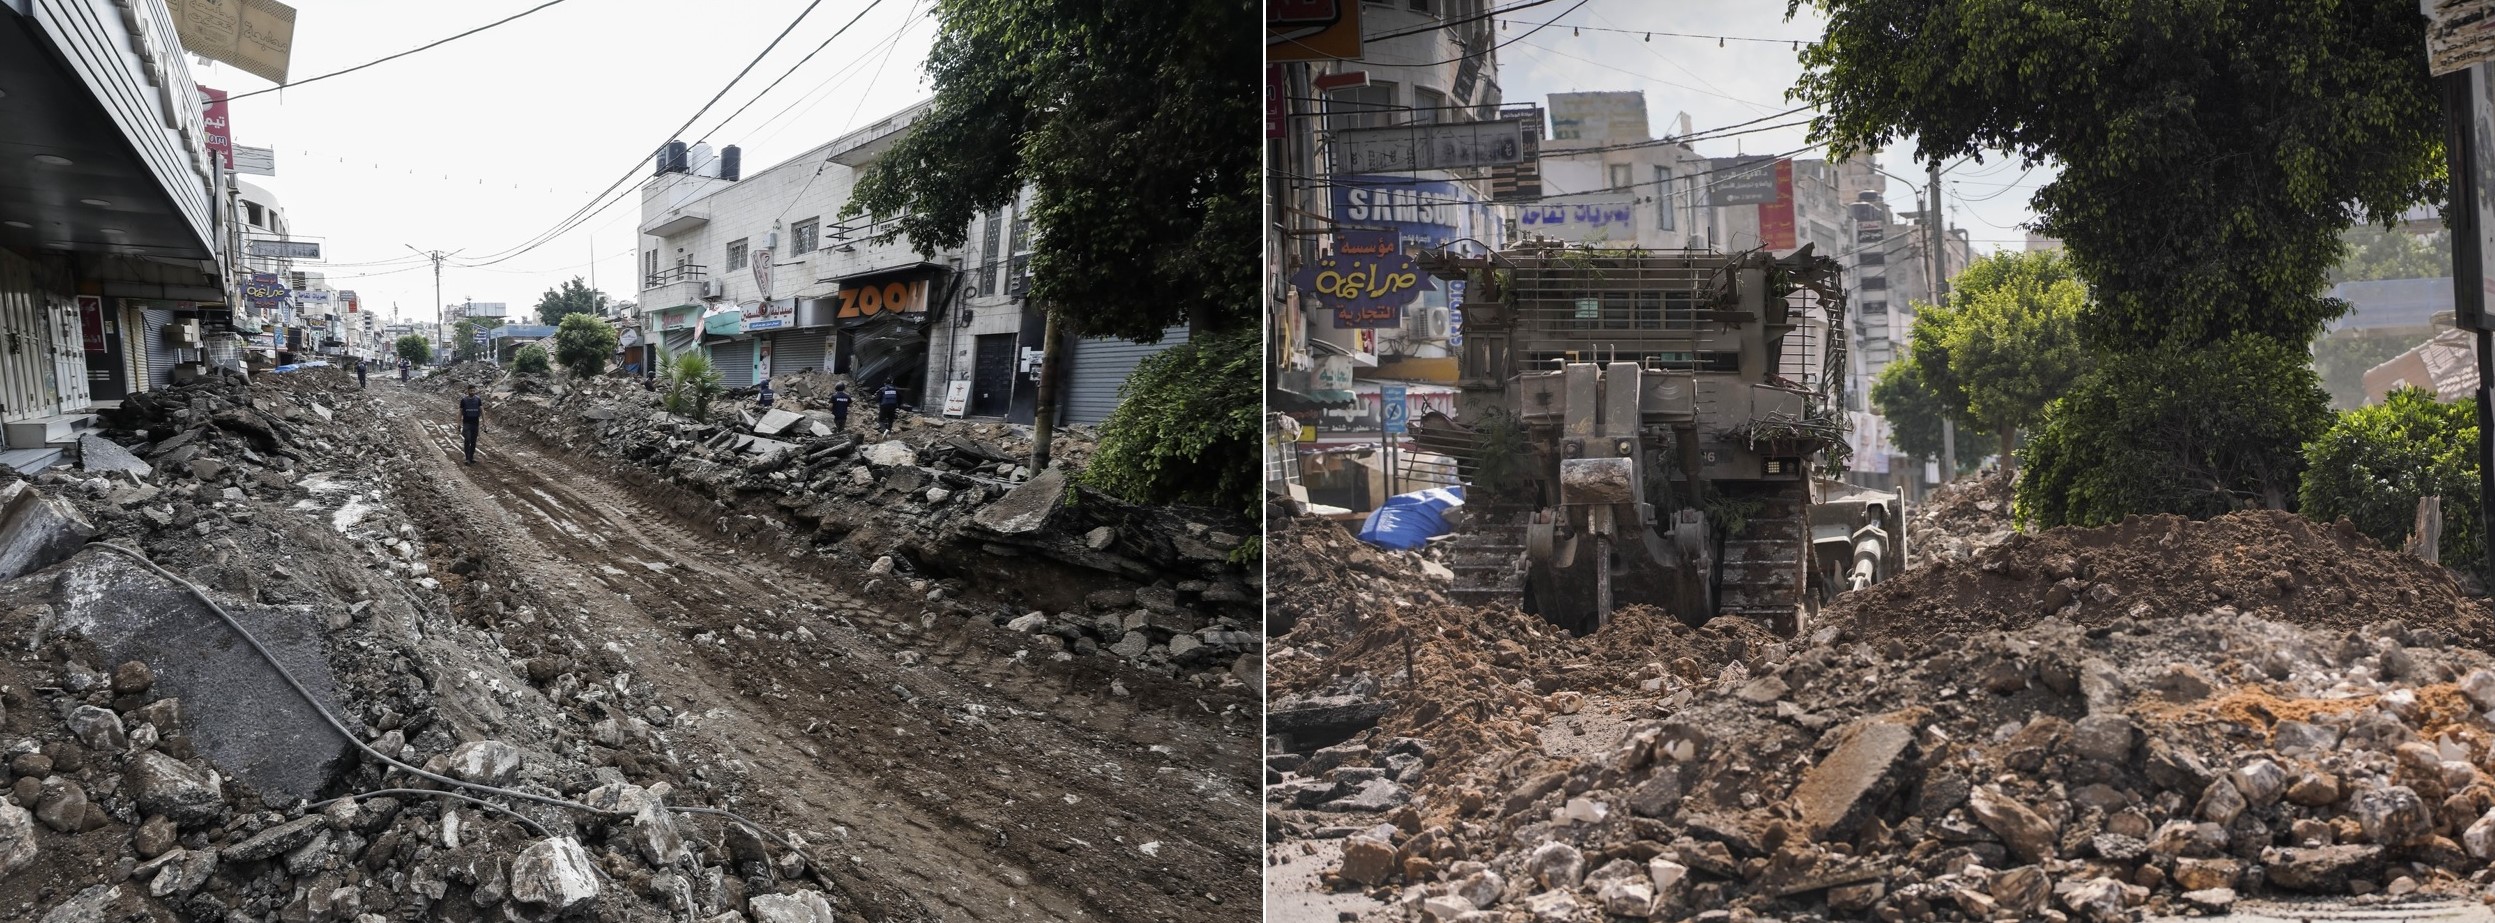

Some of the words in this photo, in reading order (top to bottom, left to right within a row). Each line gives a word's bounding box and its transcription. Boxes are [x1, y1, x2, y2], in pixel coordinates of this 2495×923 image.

[1337, 236, 1395, 258] مؤسسة
[247, 282, 285, 298] ضراغمة
[1316, 261, 1417, 299] ضراغمة
[837, 280, 929, 318] ZOOM
[770, 305, 793, 318] صيدلية
[1335, 303, 1396, 326] التجارية
